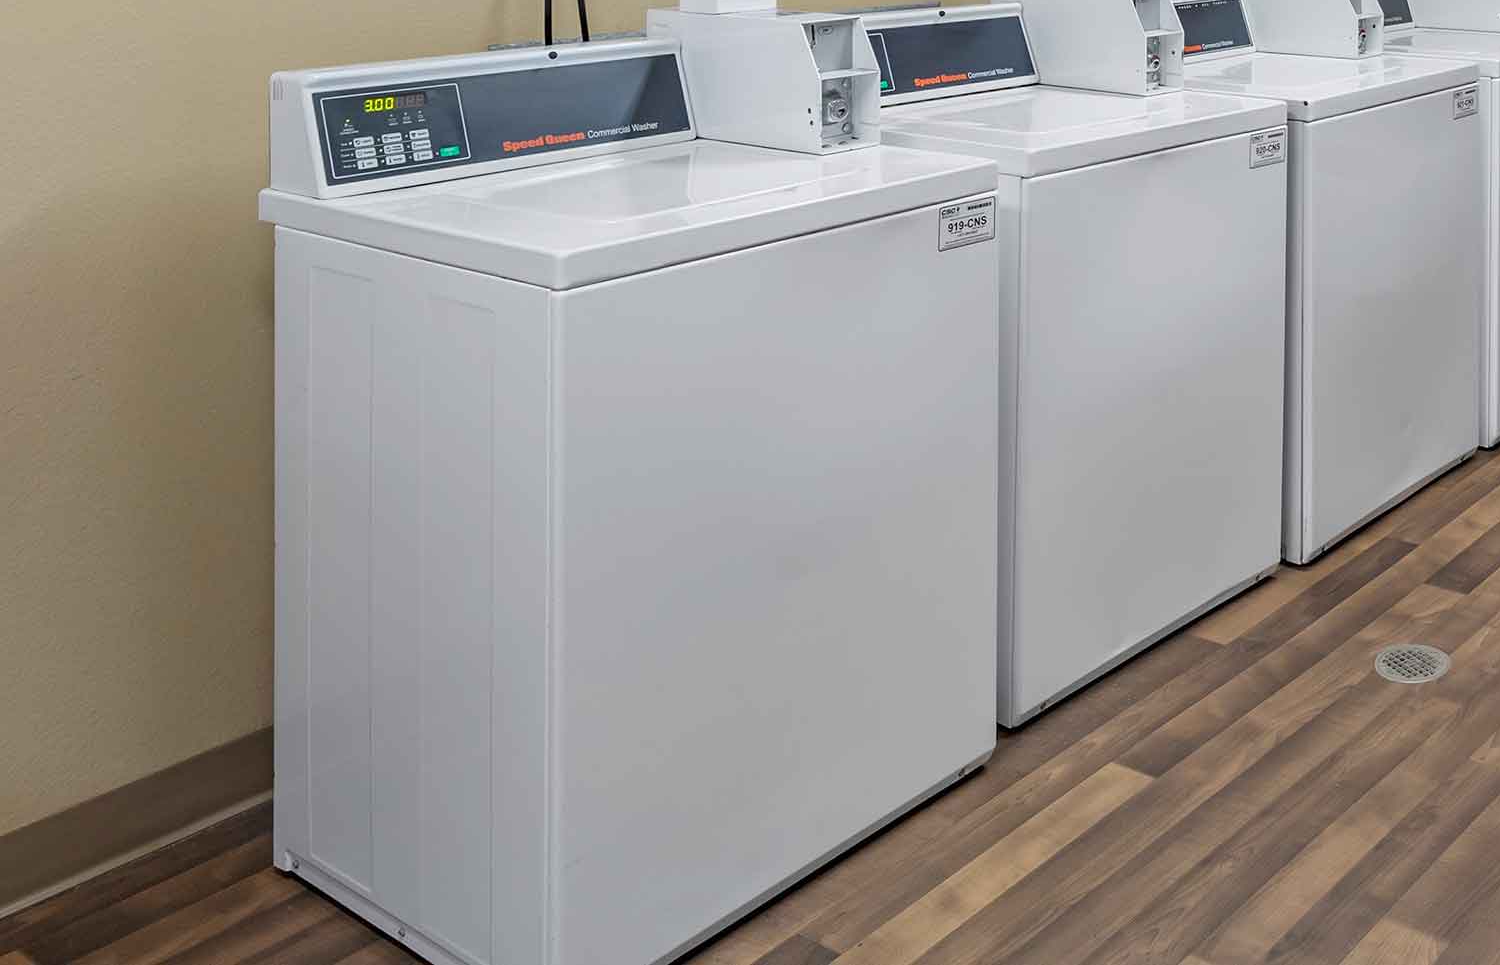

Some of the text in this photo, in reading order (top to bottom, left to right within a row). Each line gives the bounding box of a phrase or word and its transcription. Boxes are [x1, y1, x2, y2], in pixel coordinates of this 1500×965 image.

[364, 97, 395, 112] 3.00
[503, 121, 659, 152] Speed Queen Commercial Washer
[947, 215, 987, 233] 919-CNS
